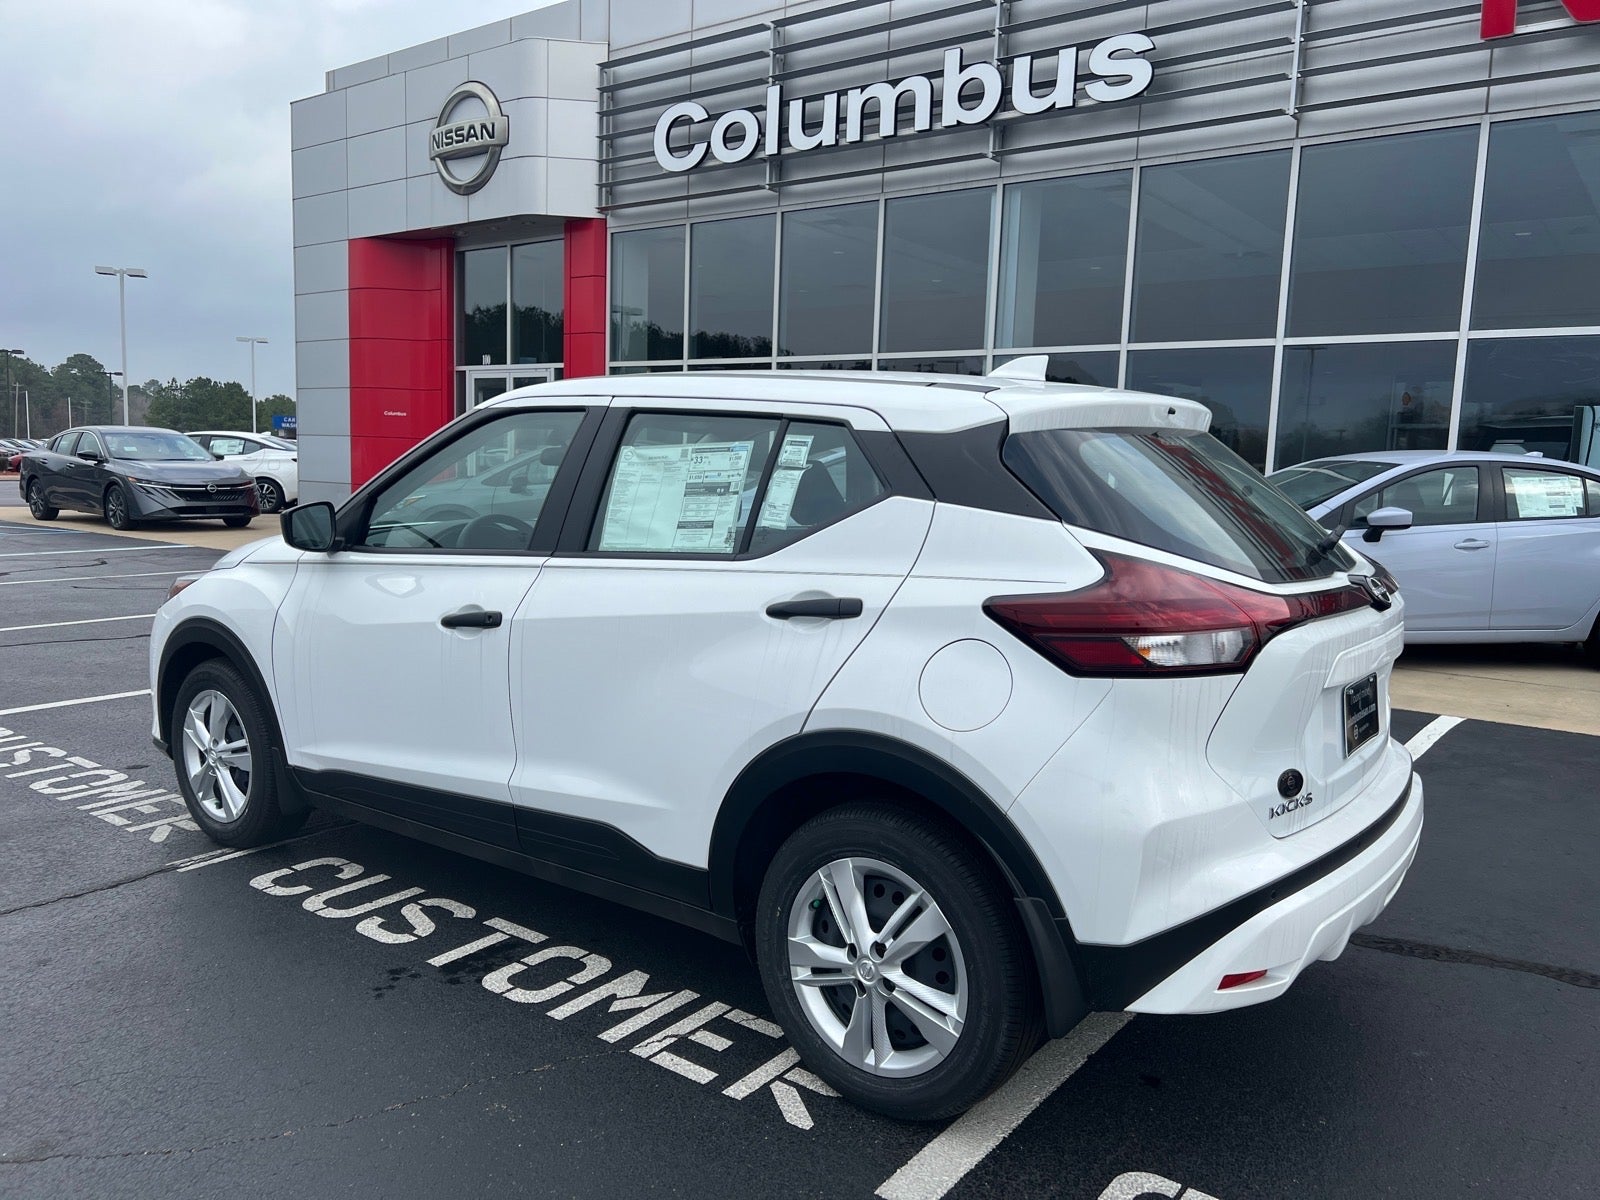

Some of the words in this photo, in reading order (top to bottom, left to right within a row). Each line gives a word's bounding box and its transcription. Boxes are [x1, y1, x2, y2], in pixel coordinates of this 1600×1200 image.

[653, 32, 1156, 172] Columbus
[432, 122, 496, 151] NISSAN
[1269, 792, 1313, 820] KICKS
